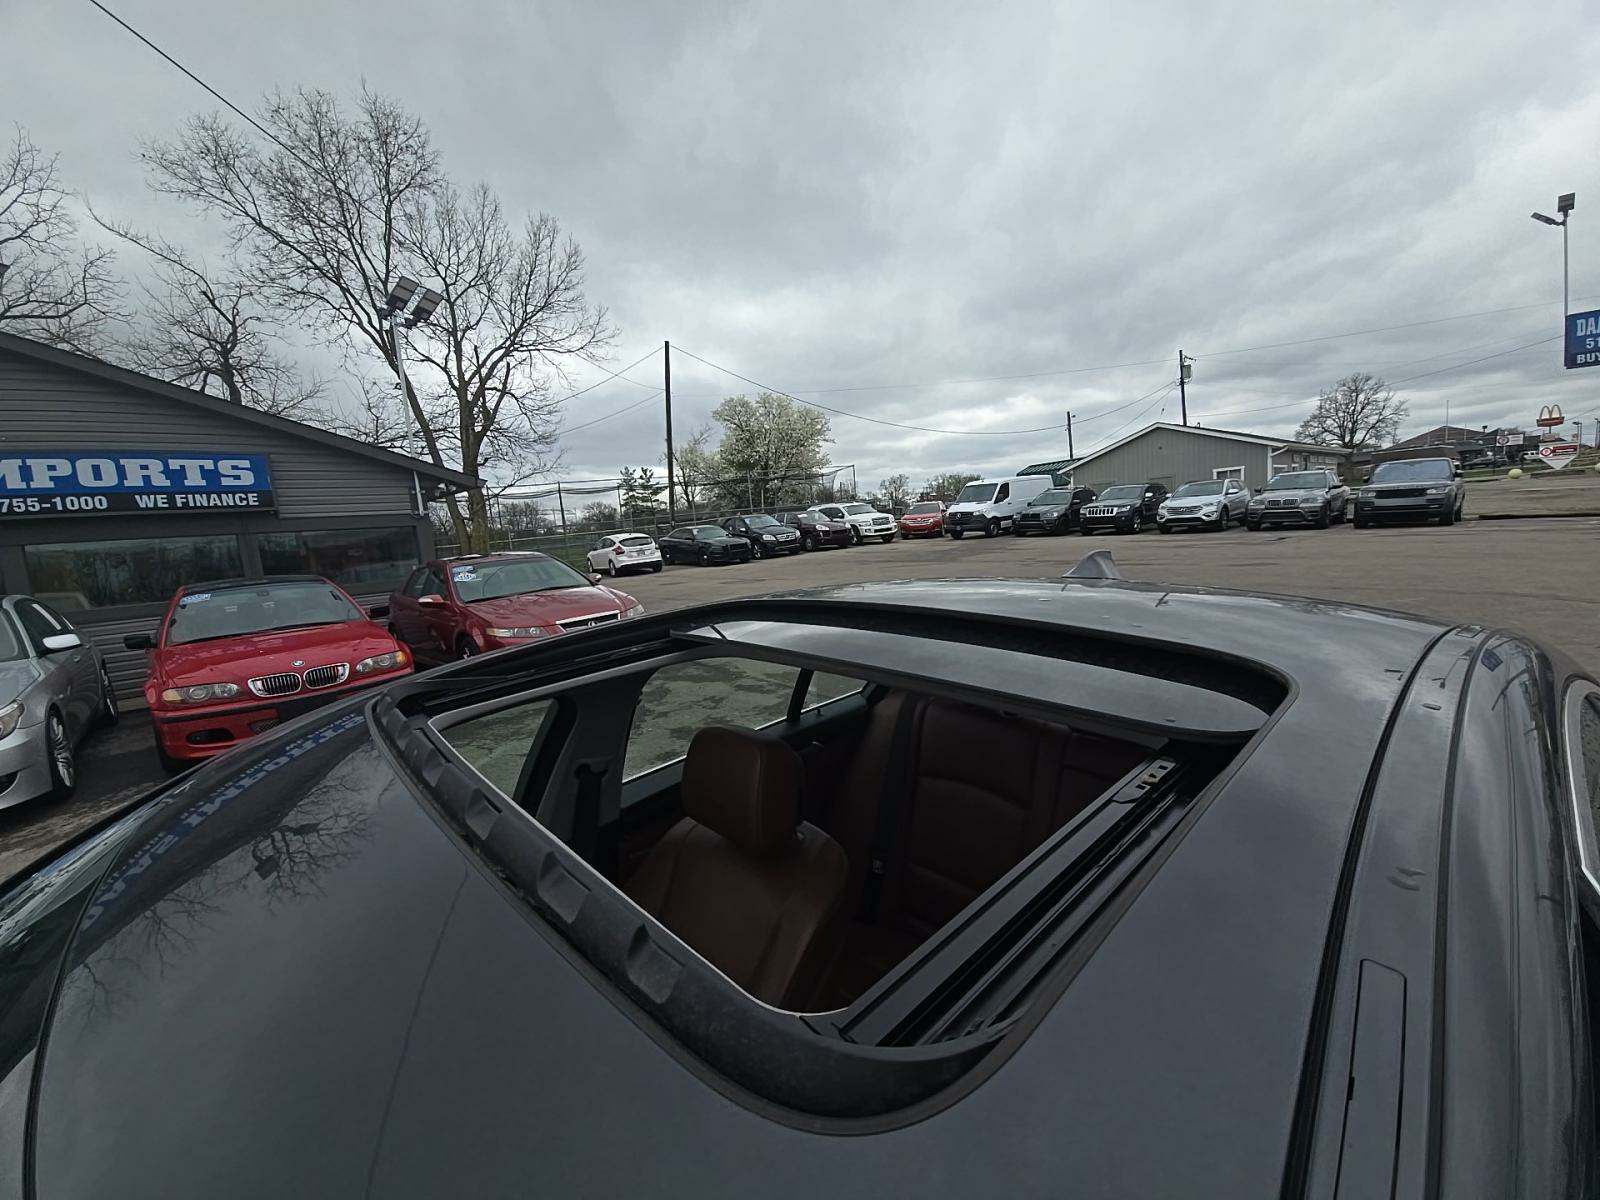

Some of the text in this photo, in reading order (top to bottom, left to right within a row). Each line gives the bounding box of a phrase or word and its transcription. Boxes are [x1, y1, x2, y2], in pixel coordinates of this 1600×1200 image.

[1576, 316, 1600, 337] DA
[0, 492, 260, 513] 755-1000 WE FINANCE
